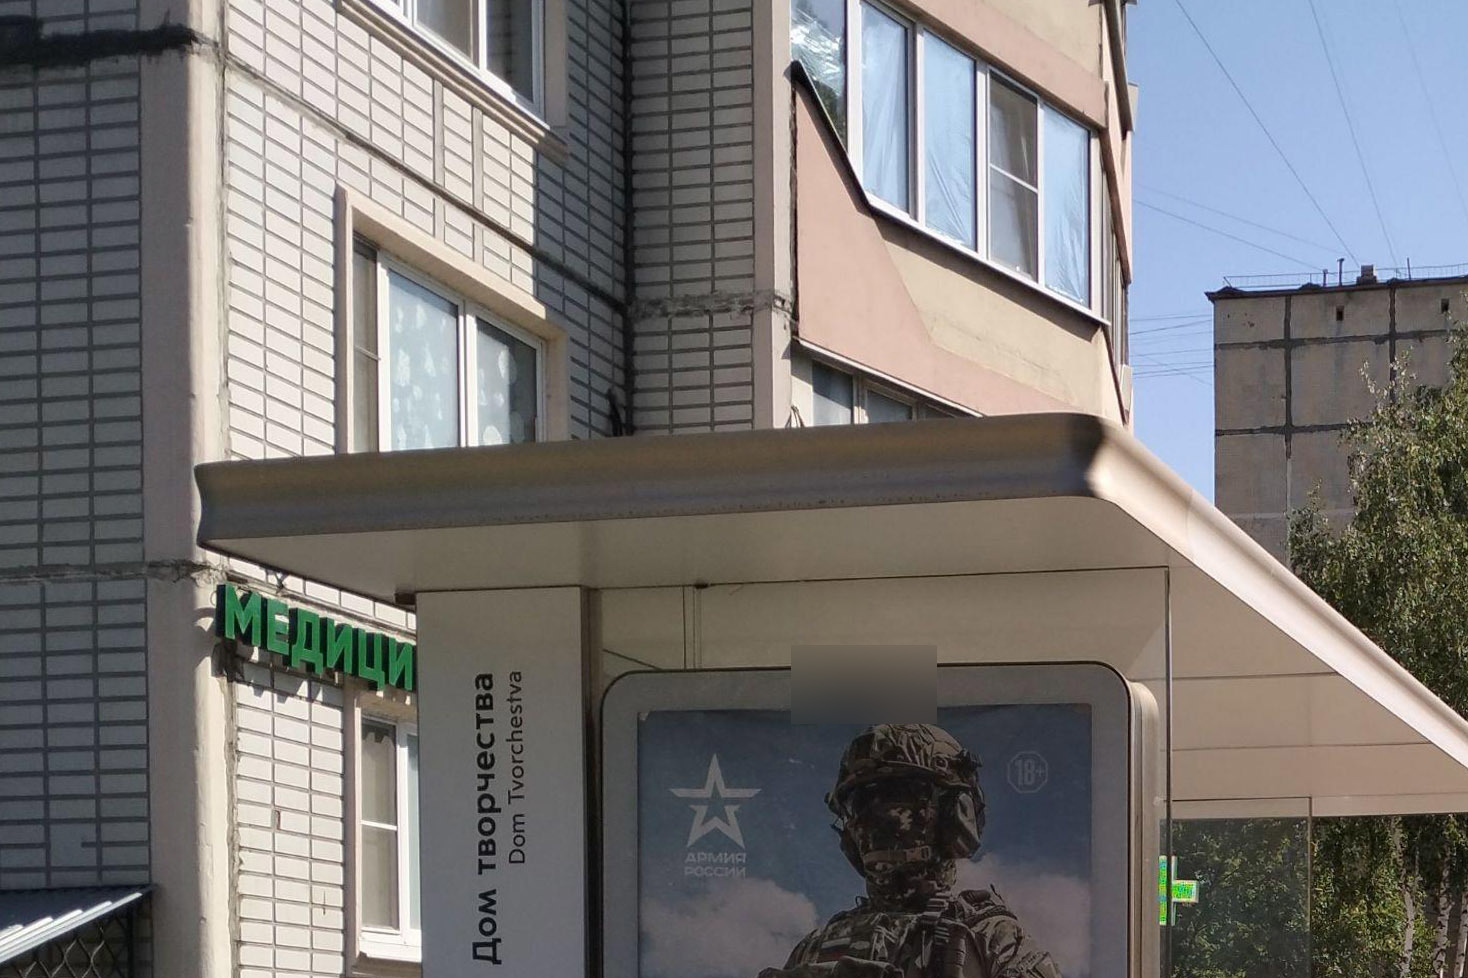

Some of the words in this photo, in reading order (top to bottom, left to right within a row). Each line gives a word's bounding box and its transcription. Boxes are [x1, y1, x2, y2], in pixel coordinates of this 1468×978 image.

[506, 670, 525, 804] Tvorchestva
[475, 673, 502, 875] творчества
[1014, 758, 1045, 787] 18+
[508, 815, 525, 865] Dom
[684, 852, 746, 864] АРМИЯ
[684, 866, 746, 878] РОССИИ
[472, 889, 502, 966] Дом
